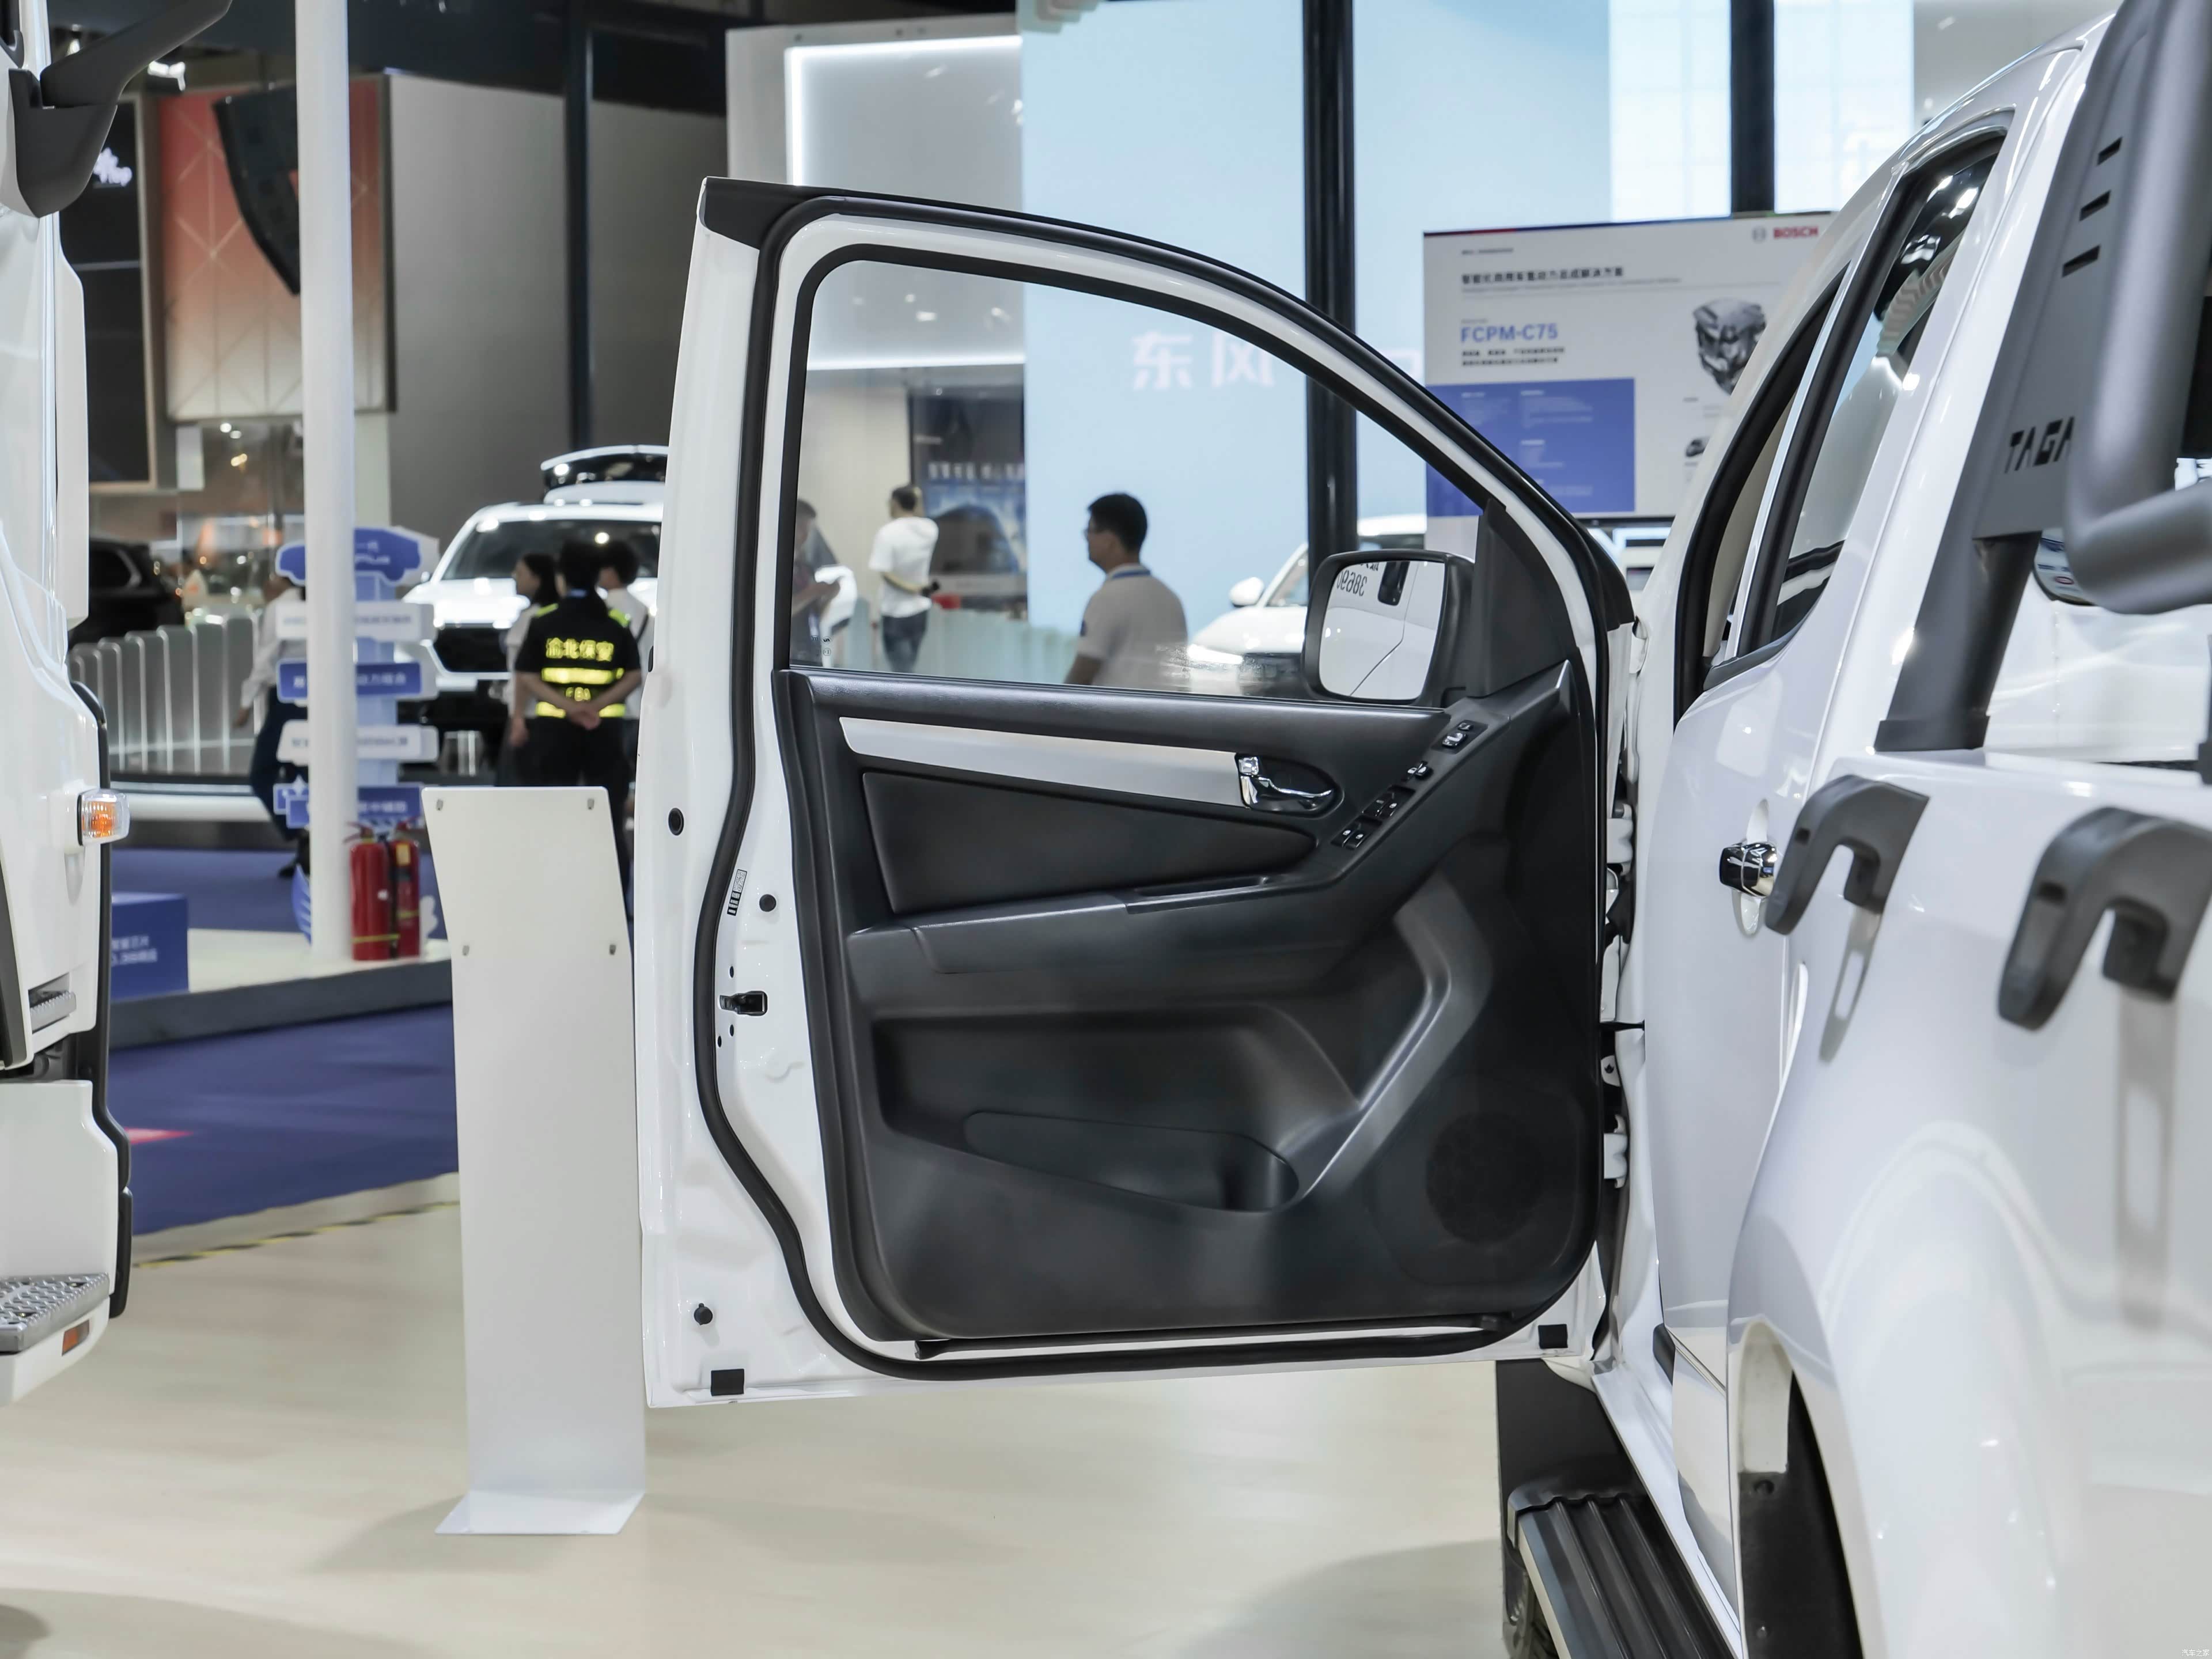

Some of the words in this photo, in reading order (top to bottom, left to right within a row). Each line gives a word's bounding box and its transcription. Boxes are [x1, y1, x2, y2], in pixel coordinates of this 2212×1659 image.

[1774, 226, 1819, 239] BOSCH
[1460, 323, 1558, 343] FCPM-C75
[1131, 328, 1277, 390] 东风
[2004, 416, 2075, 474] TAGA
